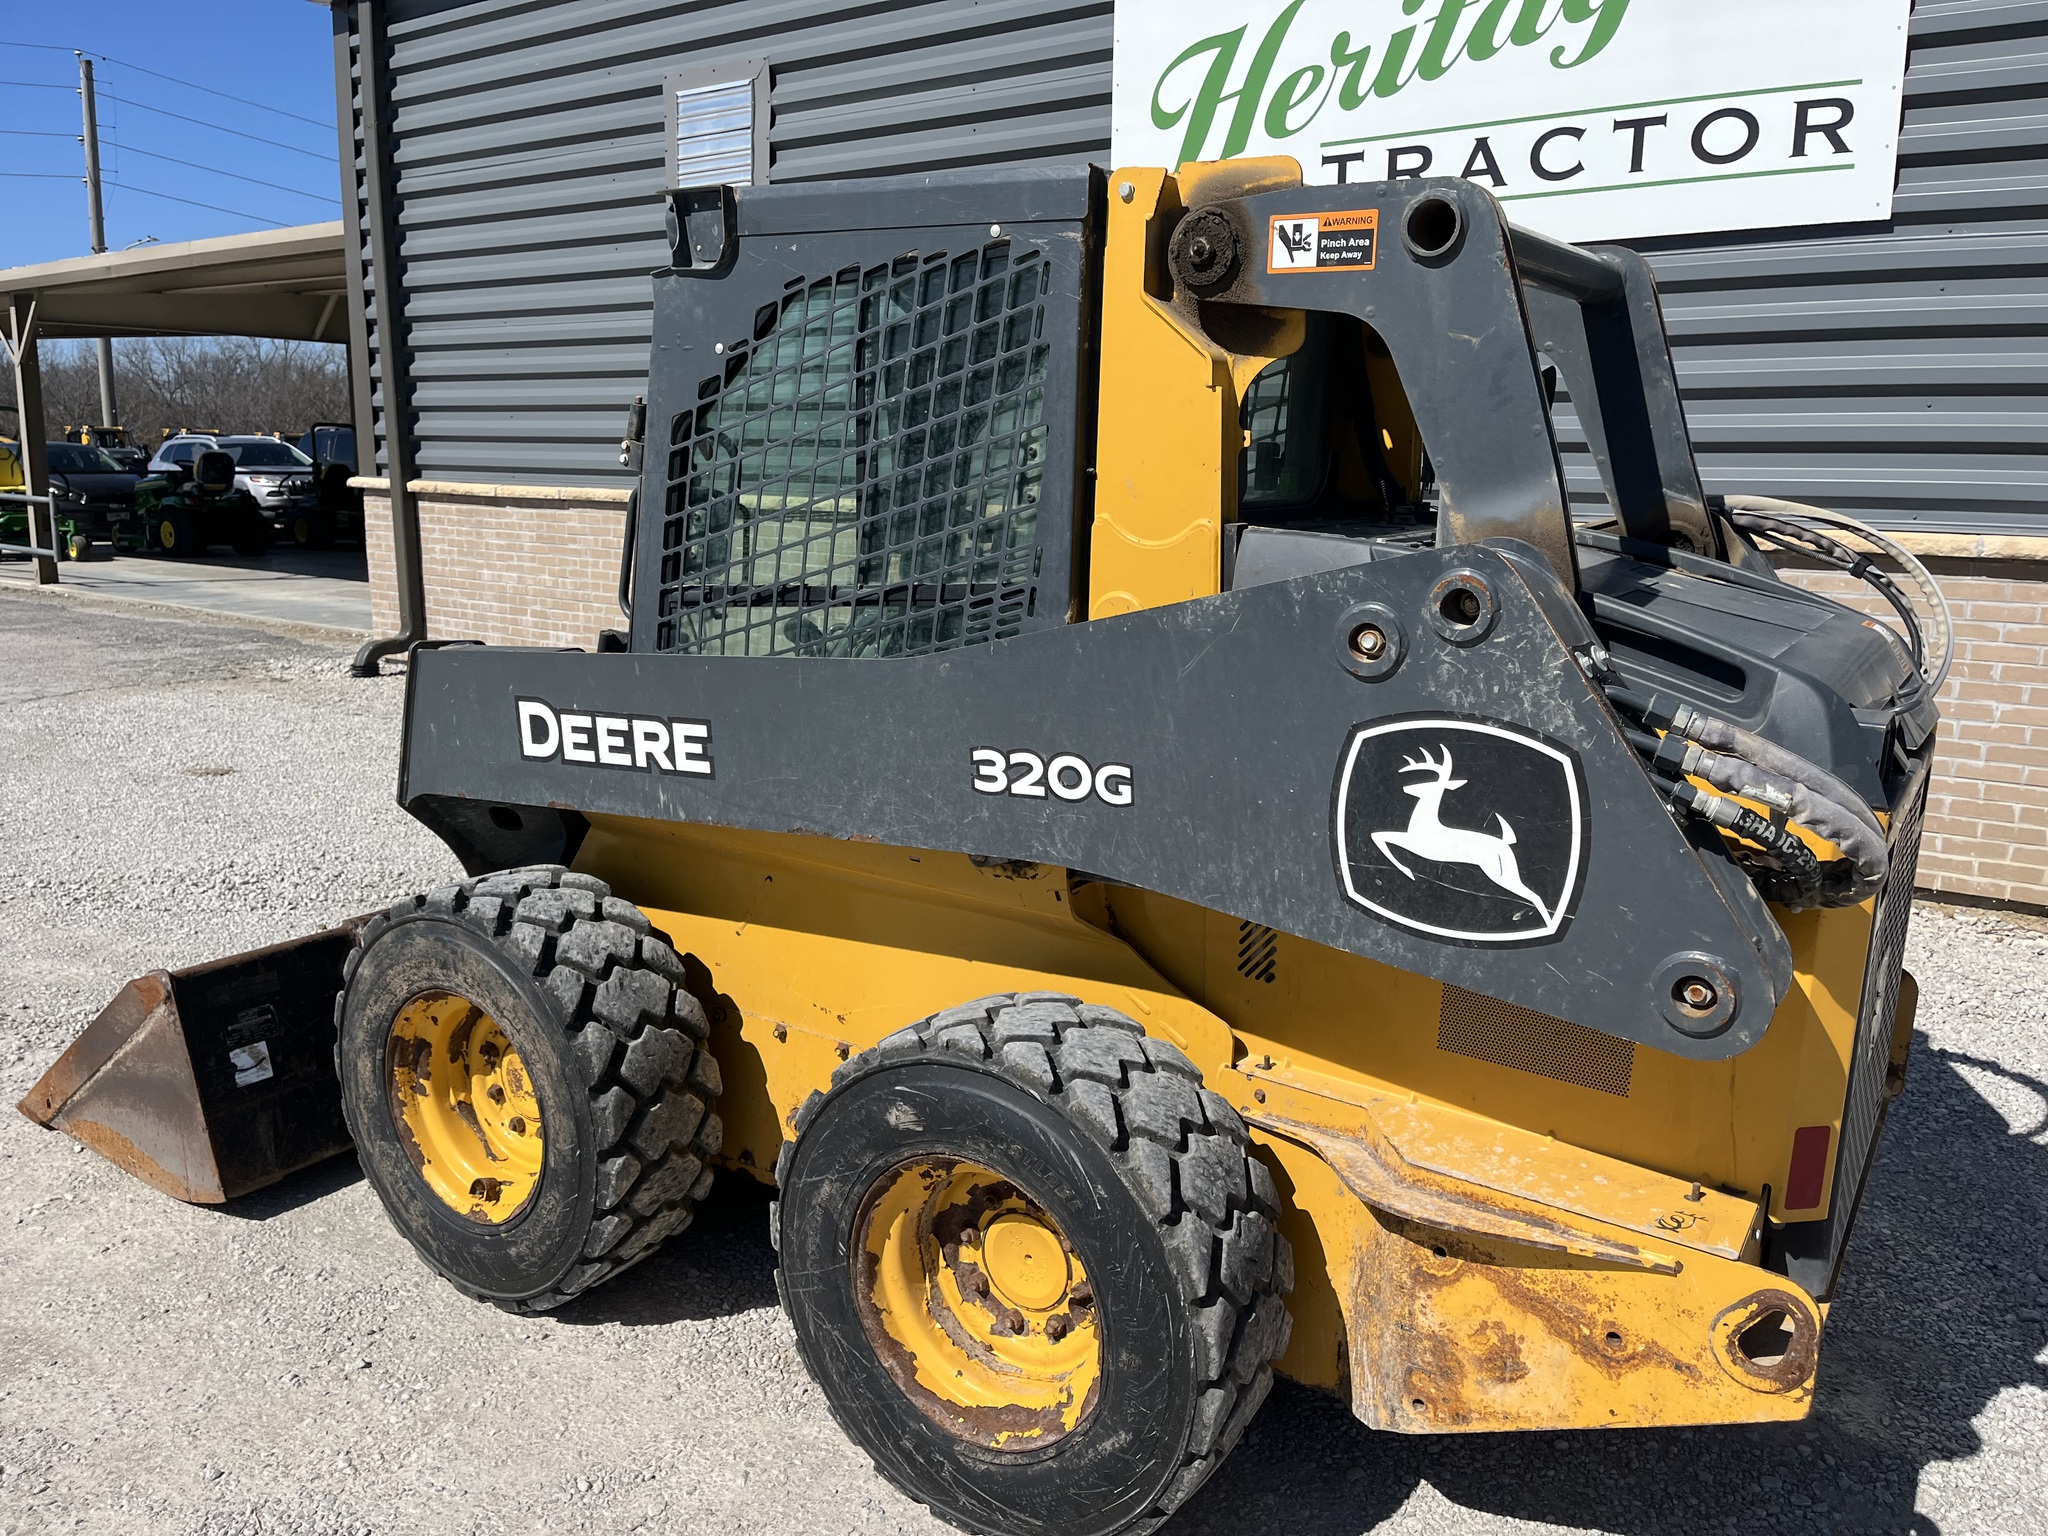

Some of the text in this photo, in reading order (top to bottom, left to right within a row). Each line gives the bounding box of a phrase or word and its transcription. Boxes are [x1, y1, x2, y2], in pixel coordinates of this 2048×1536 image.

[1321, 97, 1854, 187] TRACTOR
[1332, 216, 1373, 225] WARNING
[1320, 251, 1362, 261] Keep Away
[1321, 238, 1370, 248] Pinch Area
[518, 700, 711, 776] DEERE
[973, 749, 1133, 805] 320G
